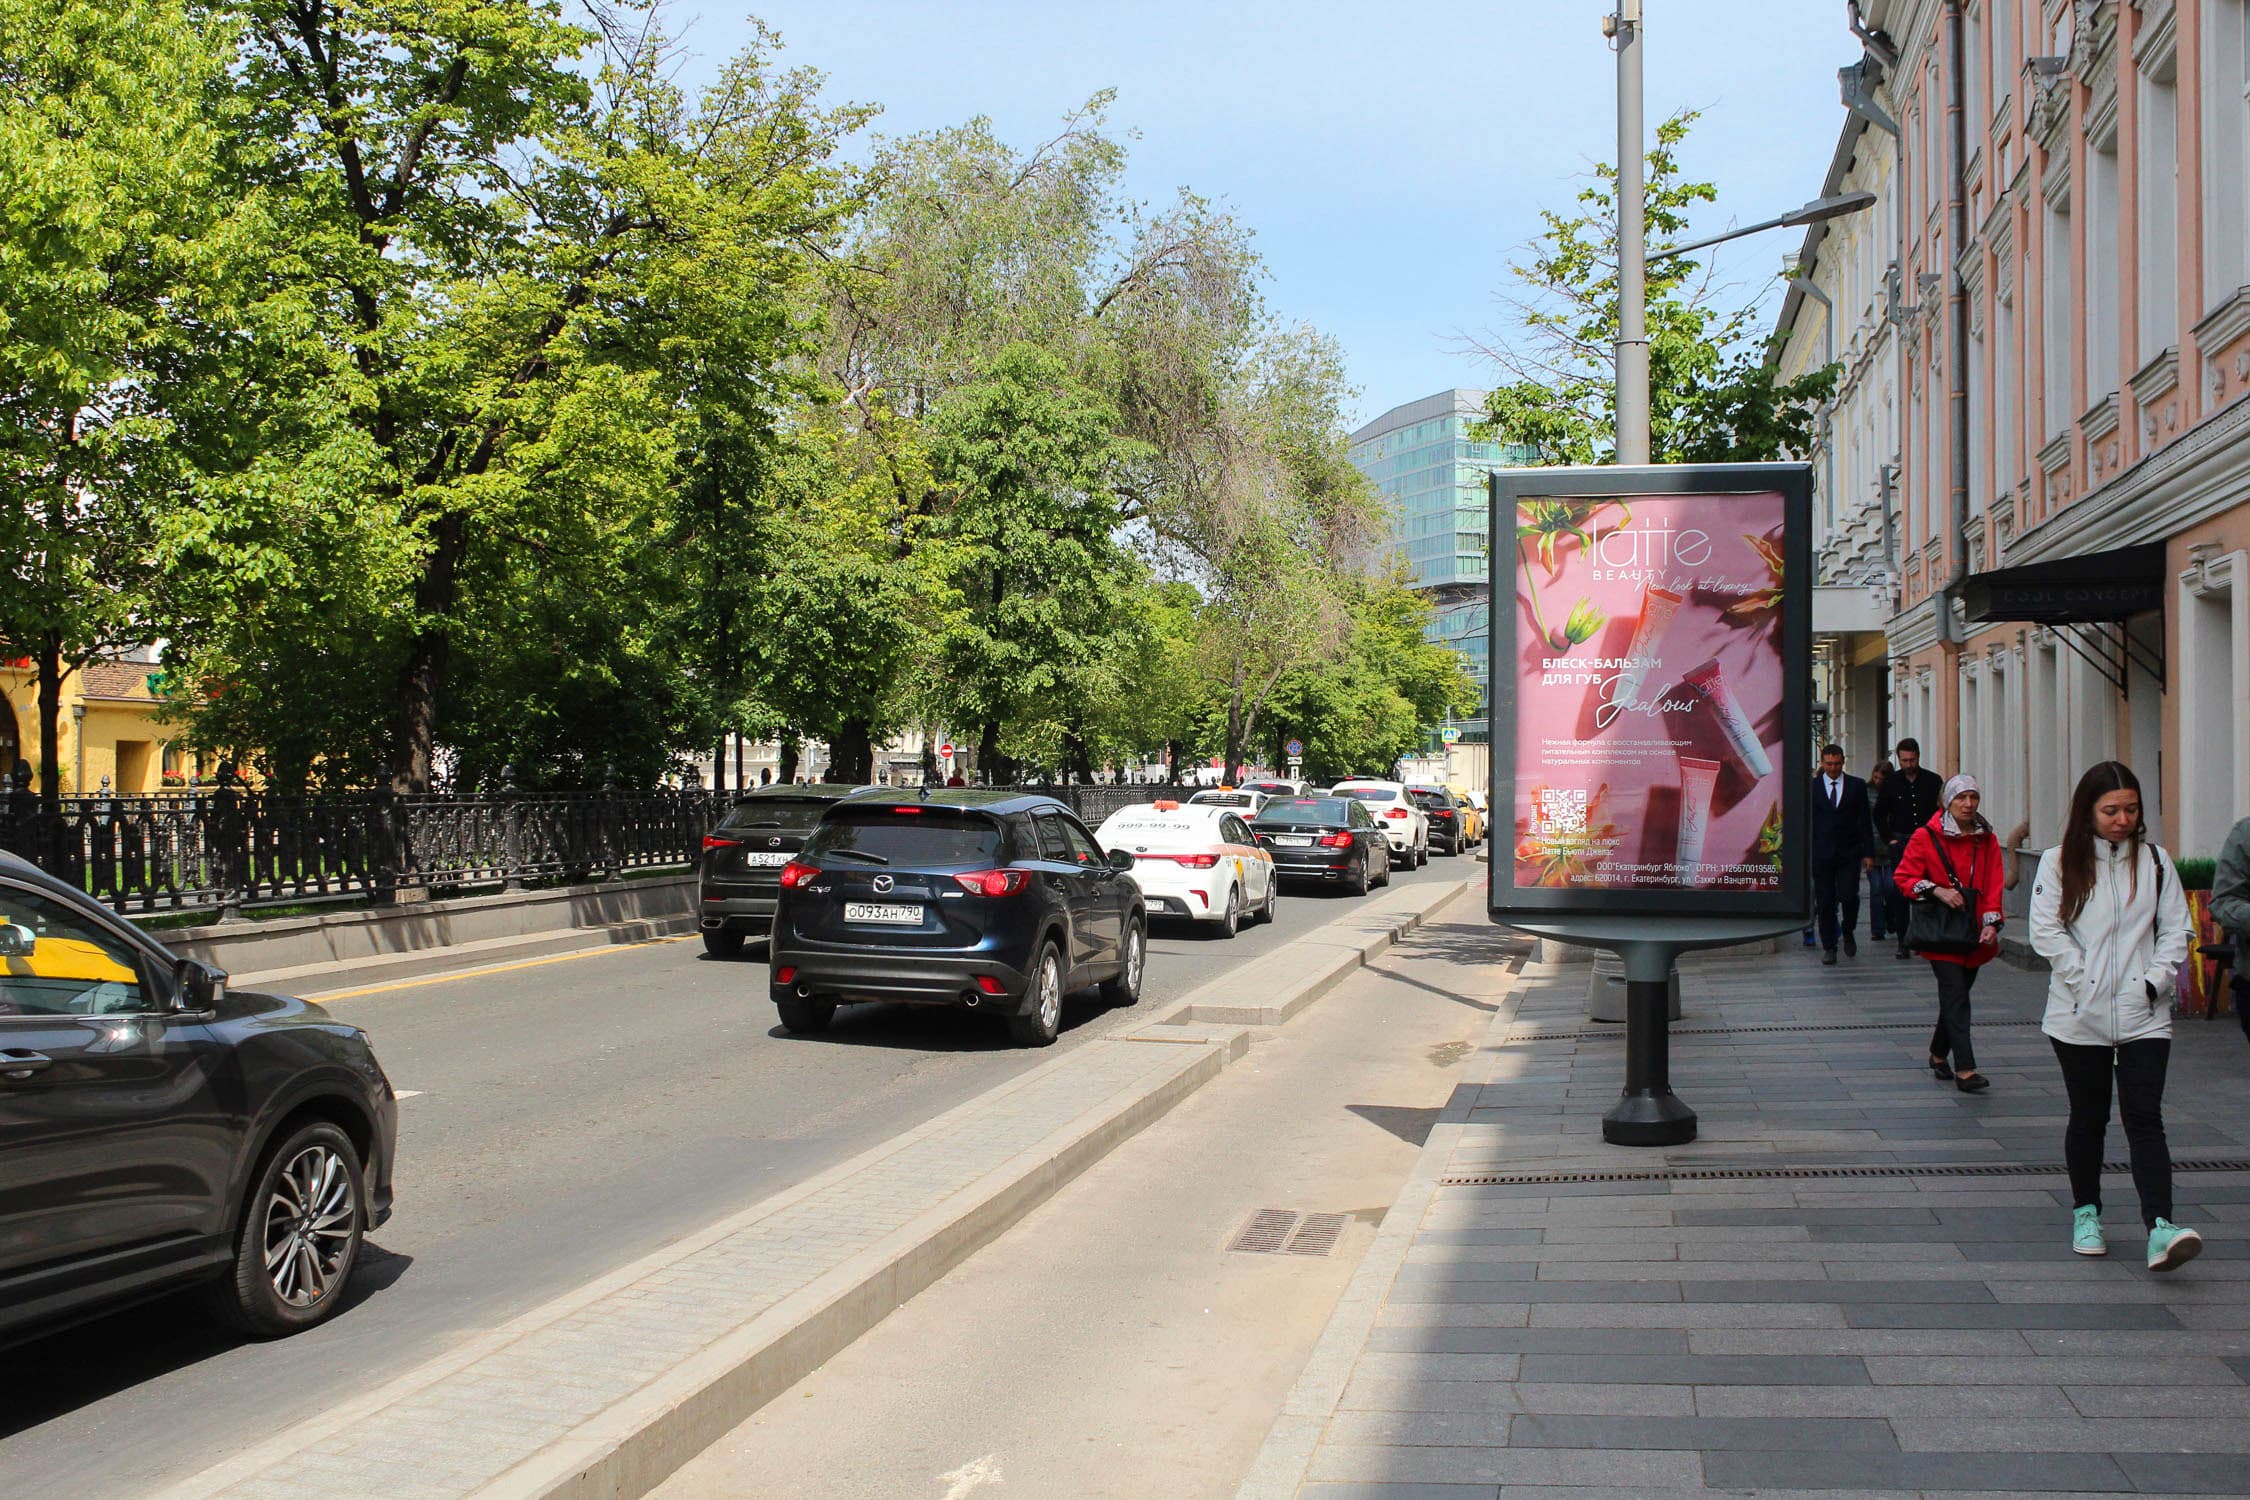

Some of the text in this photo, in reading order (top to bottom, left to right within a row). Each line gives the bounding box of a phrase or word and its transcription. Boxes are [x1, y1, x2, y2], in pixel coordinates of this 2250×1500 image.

[1592, 517, 1712, 568] latte
[1592, 569, 1668, 581] BEAUTY
[1669, 576, 1694, 592] look
[1697, 579, 1714, 591] at
[1542, 657, 1663, 670] БЛЕСК-БАЛЬЗАМ
[1542, 673, 1602, 687] ДЛЯ ГУБ
[1117, 822, 1191, 831] 999-99-99
[1591, 838, 1600, 847] на
[1601, 838, 1621, 848] люкс
[1586, 847, 1615, 859] Джелас
[1769, 876, 1779, 885] 62
[900, 905, 921, 917] 790
